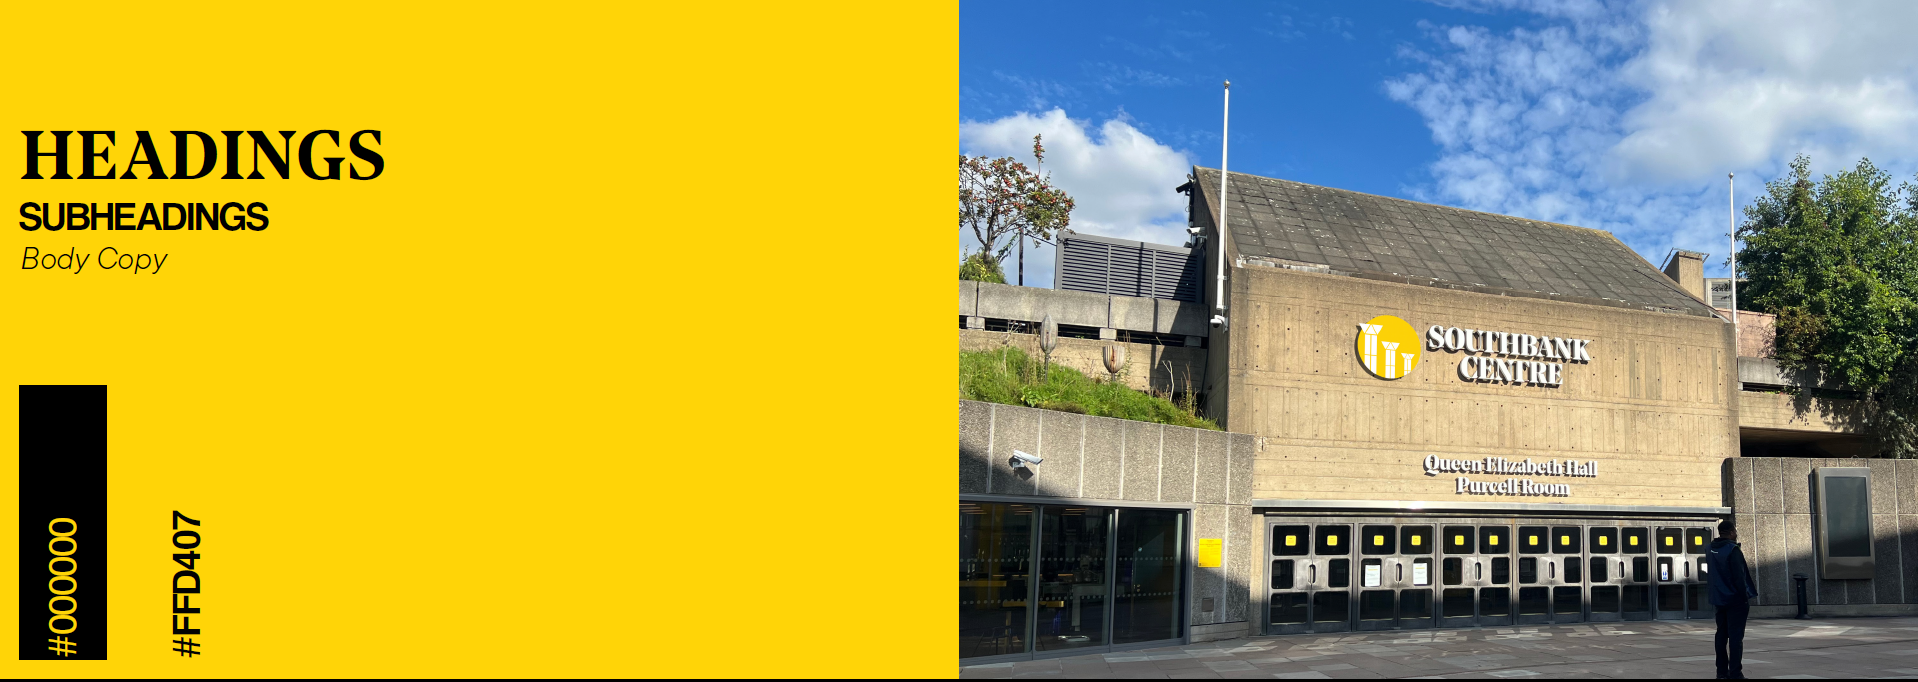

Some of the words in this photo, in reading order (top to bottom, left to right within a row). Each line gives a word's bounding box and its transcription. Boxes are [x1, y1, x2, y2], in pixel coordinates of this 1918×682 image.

[1428, 325, 1591, 361] SOUTHBANK
[1459, 356, 1564, 385] CENTRE
[1424, 454, 1482, 475] Queen
[1485, 457, 1563, 475] Elizabeth
[1565, 459, 1598, 476] Hall
[1457, 476, 1518, 494] Purcell
[1521, 478, 1571, 495] Room
